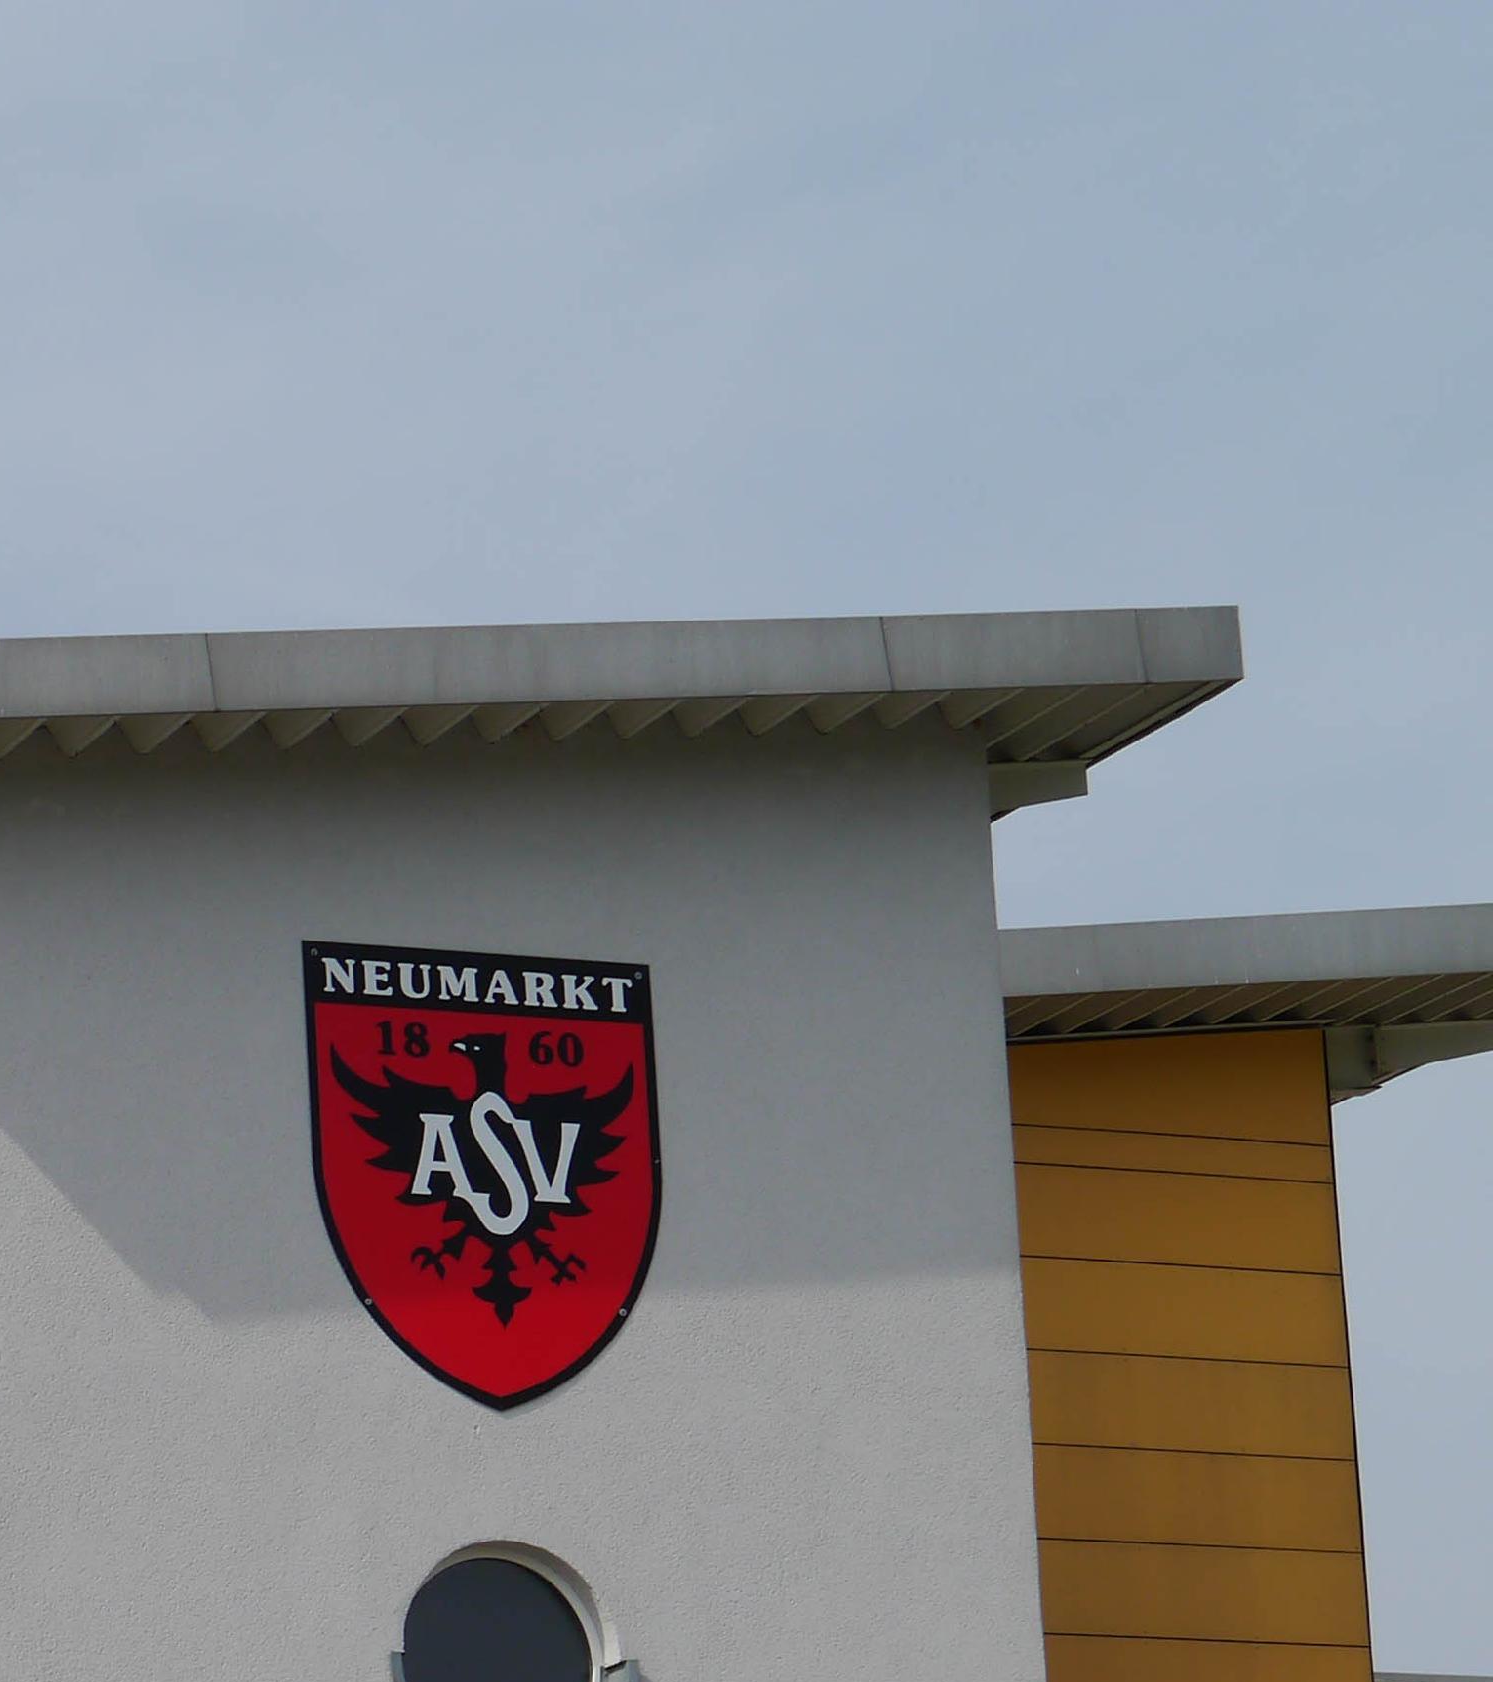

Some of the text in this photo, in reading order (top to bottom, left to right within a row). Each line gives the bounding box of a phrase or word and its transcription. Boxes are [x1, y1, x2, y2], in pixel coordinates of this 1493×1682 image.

[320, 957, 632, 1014] NEUMARKT
[375, 1020, 585, 1067] 18 60
[410, 1090, 580, 1235] ASV
